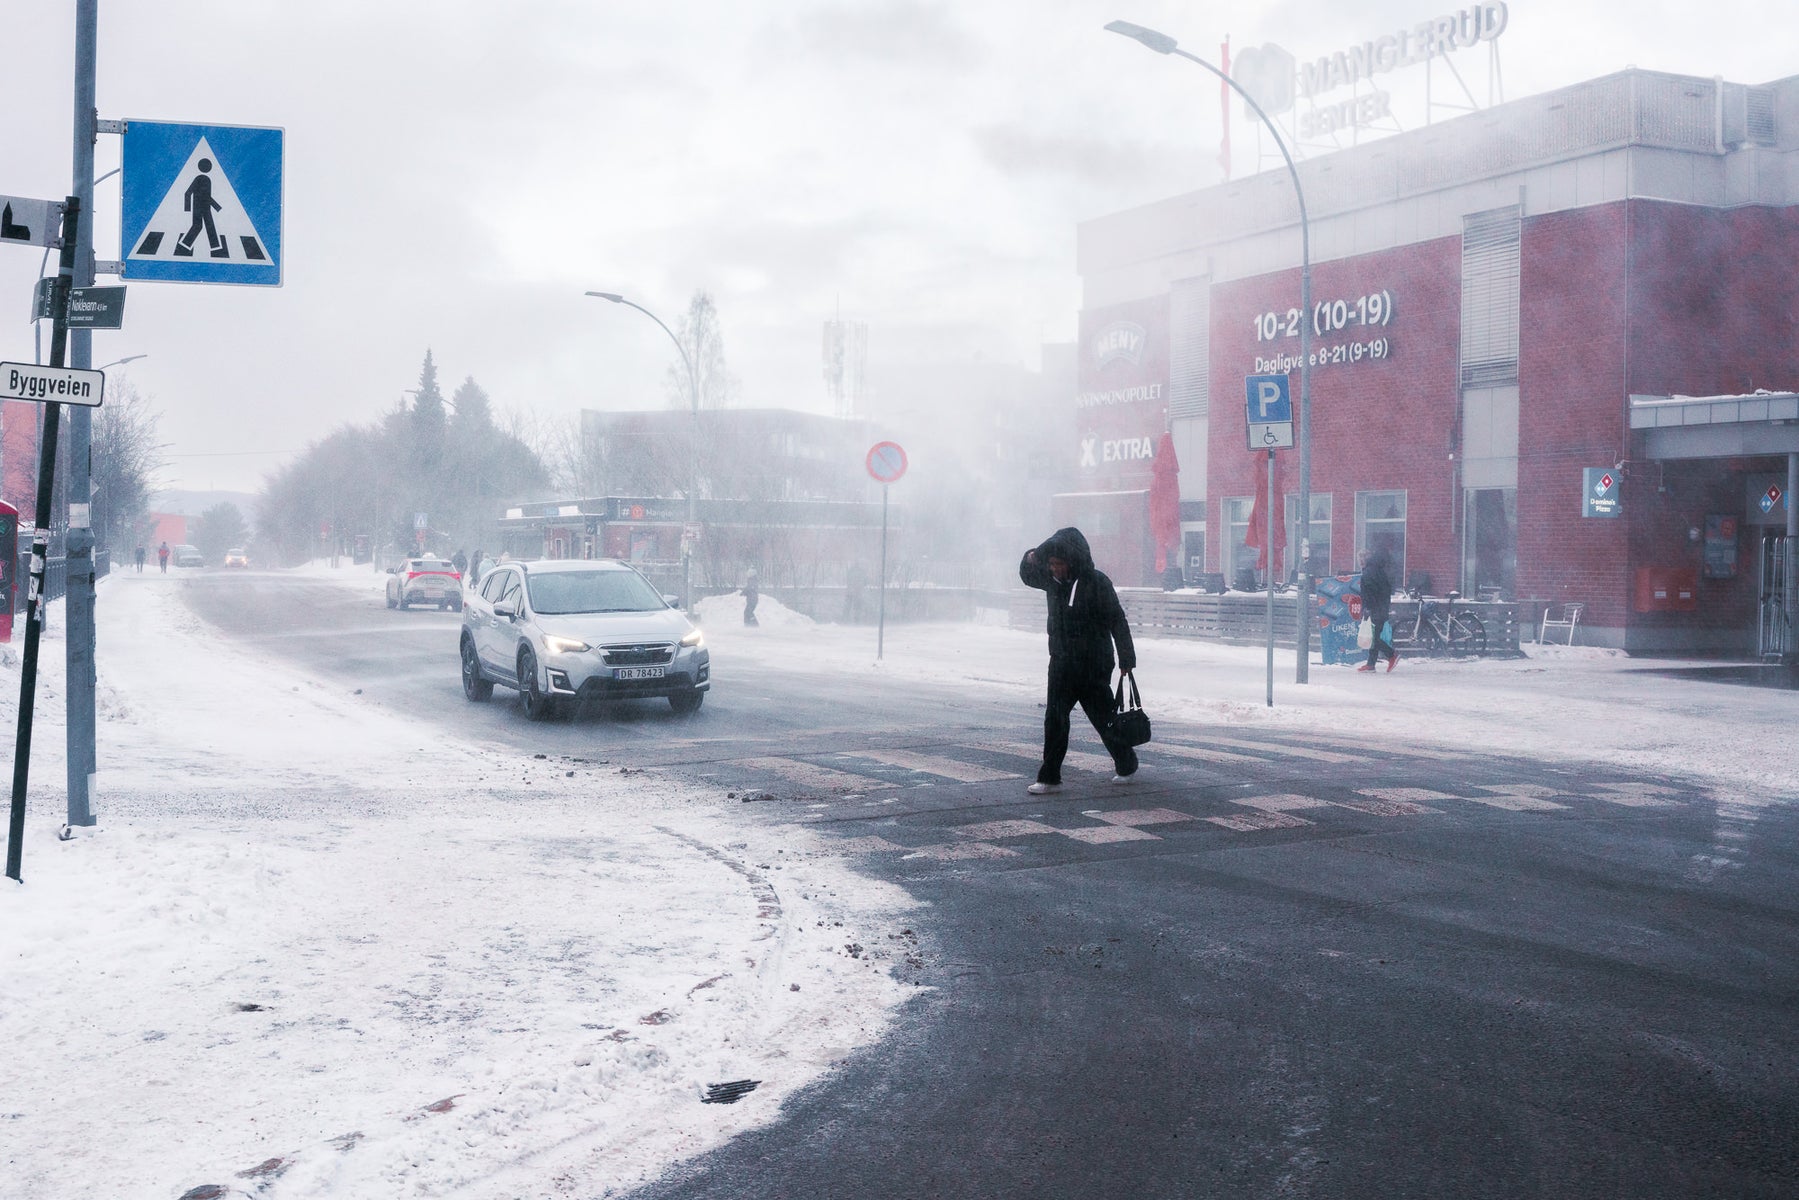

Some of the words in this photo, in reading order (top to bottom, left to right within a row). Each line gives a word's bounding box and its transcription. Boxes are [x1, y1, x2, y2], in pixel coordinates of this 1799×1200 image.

[1301, 0, 1508, 98] MANGLERUD
[1300, 90, 1392, 138] SENTER
[1254, 308, 1303, 341] 10-2
[1314, 289, 1391, 336] (10-19)
[1097, 331, 1139, 357] MENY
[1255, 353, 1316, 375] Dagligvae
[1319, 345, 1346, 364] 8-21
[1349, 337, 1388, 362] (9-19)
[10, 370, 90, 397] Byggveien
[1258, 382, 1281, 417] P
[1103, 437, 1153, 462] EXTRA
[637, 669, 663, 677] 78423
